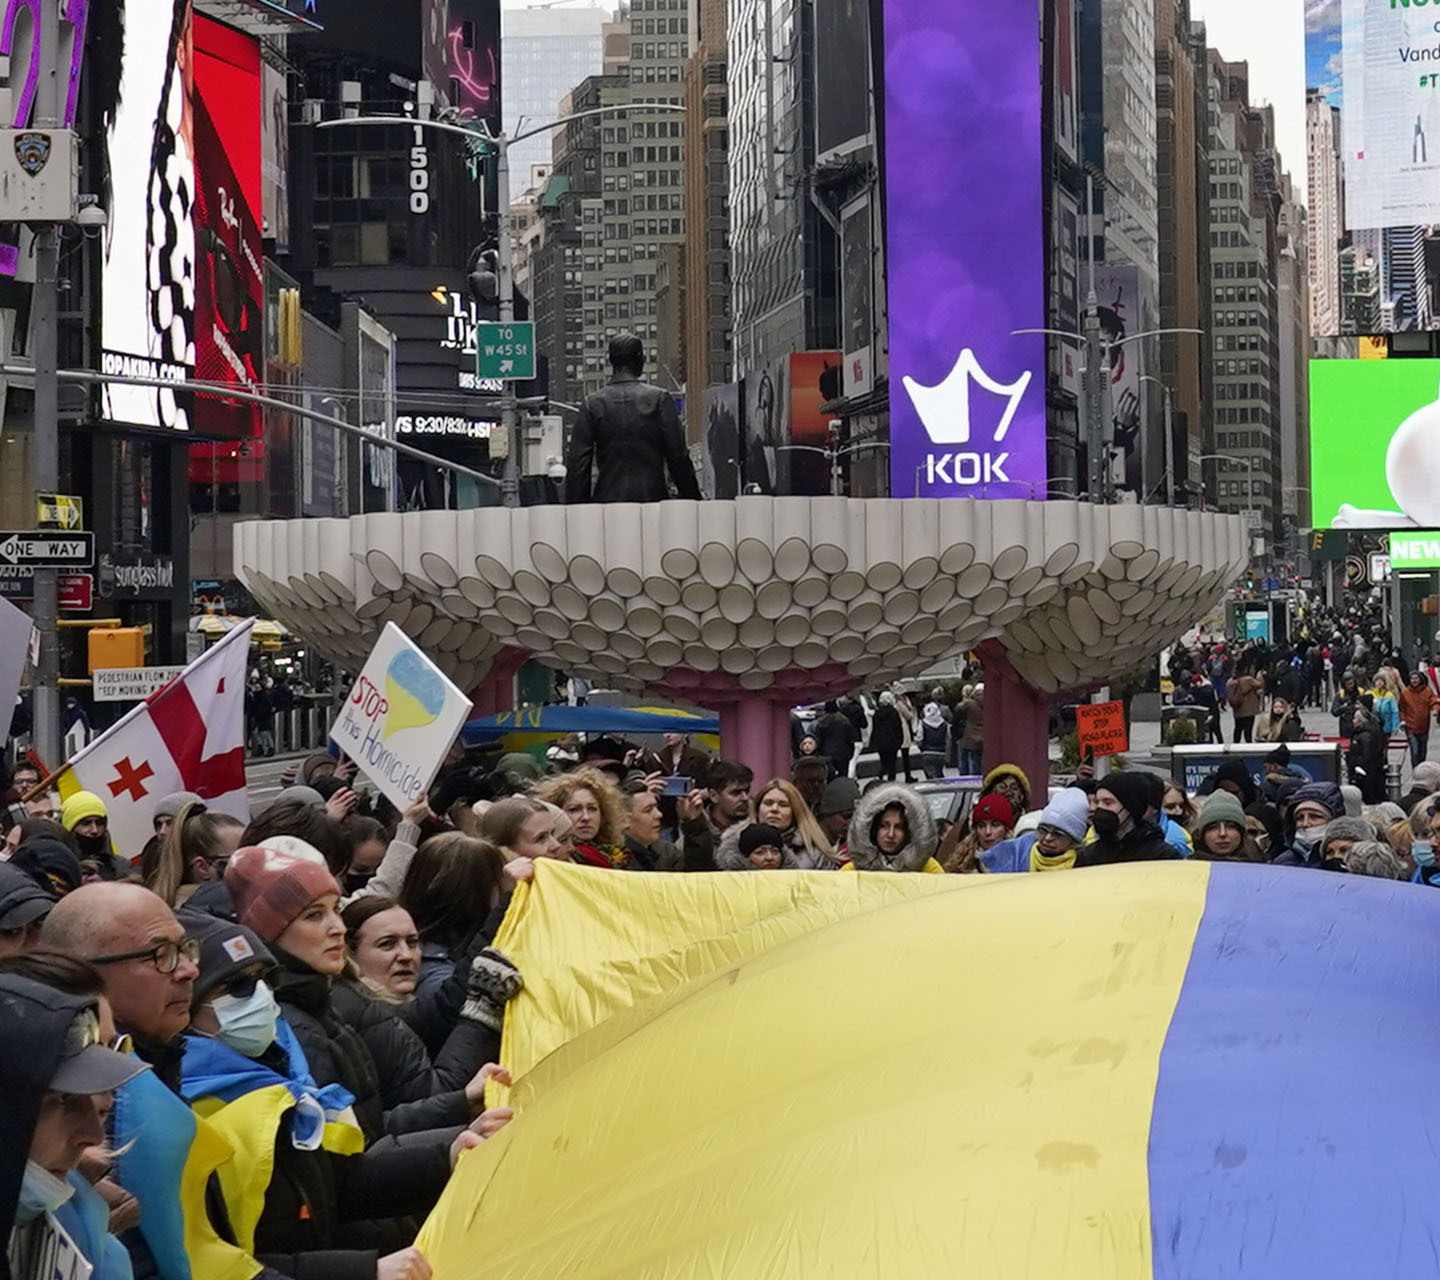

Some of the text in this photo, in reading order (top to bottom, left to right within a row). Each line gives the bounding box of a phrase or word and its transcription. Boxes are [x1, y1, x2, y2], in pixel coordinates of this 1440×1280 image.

[409, 124, 430, 214] 1500
[485, 344, 512, 356] W 45
[498, 328, 513, 340] TO
[927, 452, 1008, 484] KOK
[5, 542, 80, 556] ONE WAY
[115, 557, 156, 596] sunglass
[157, 560, 174, 588] hut
[97, 671, 164, 684] PEDESTRIAN FLOW
[351, 676, 389, 723] STOP
[359, 724, 422, 802] Homicide
